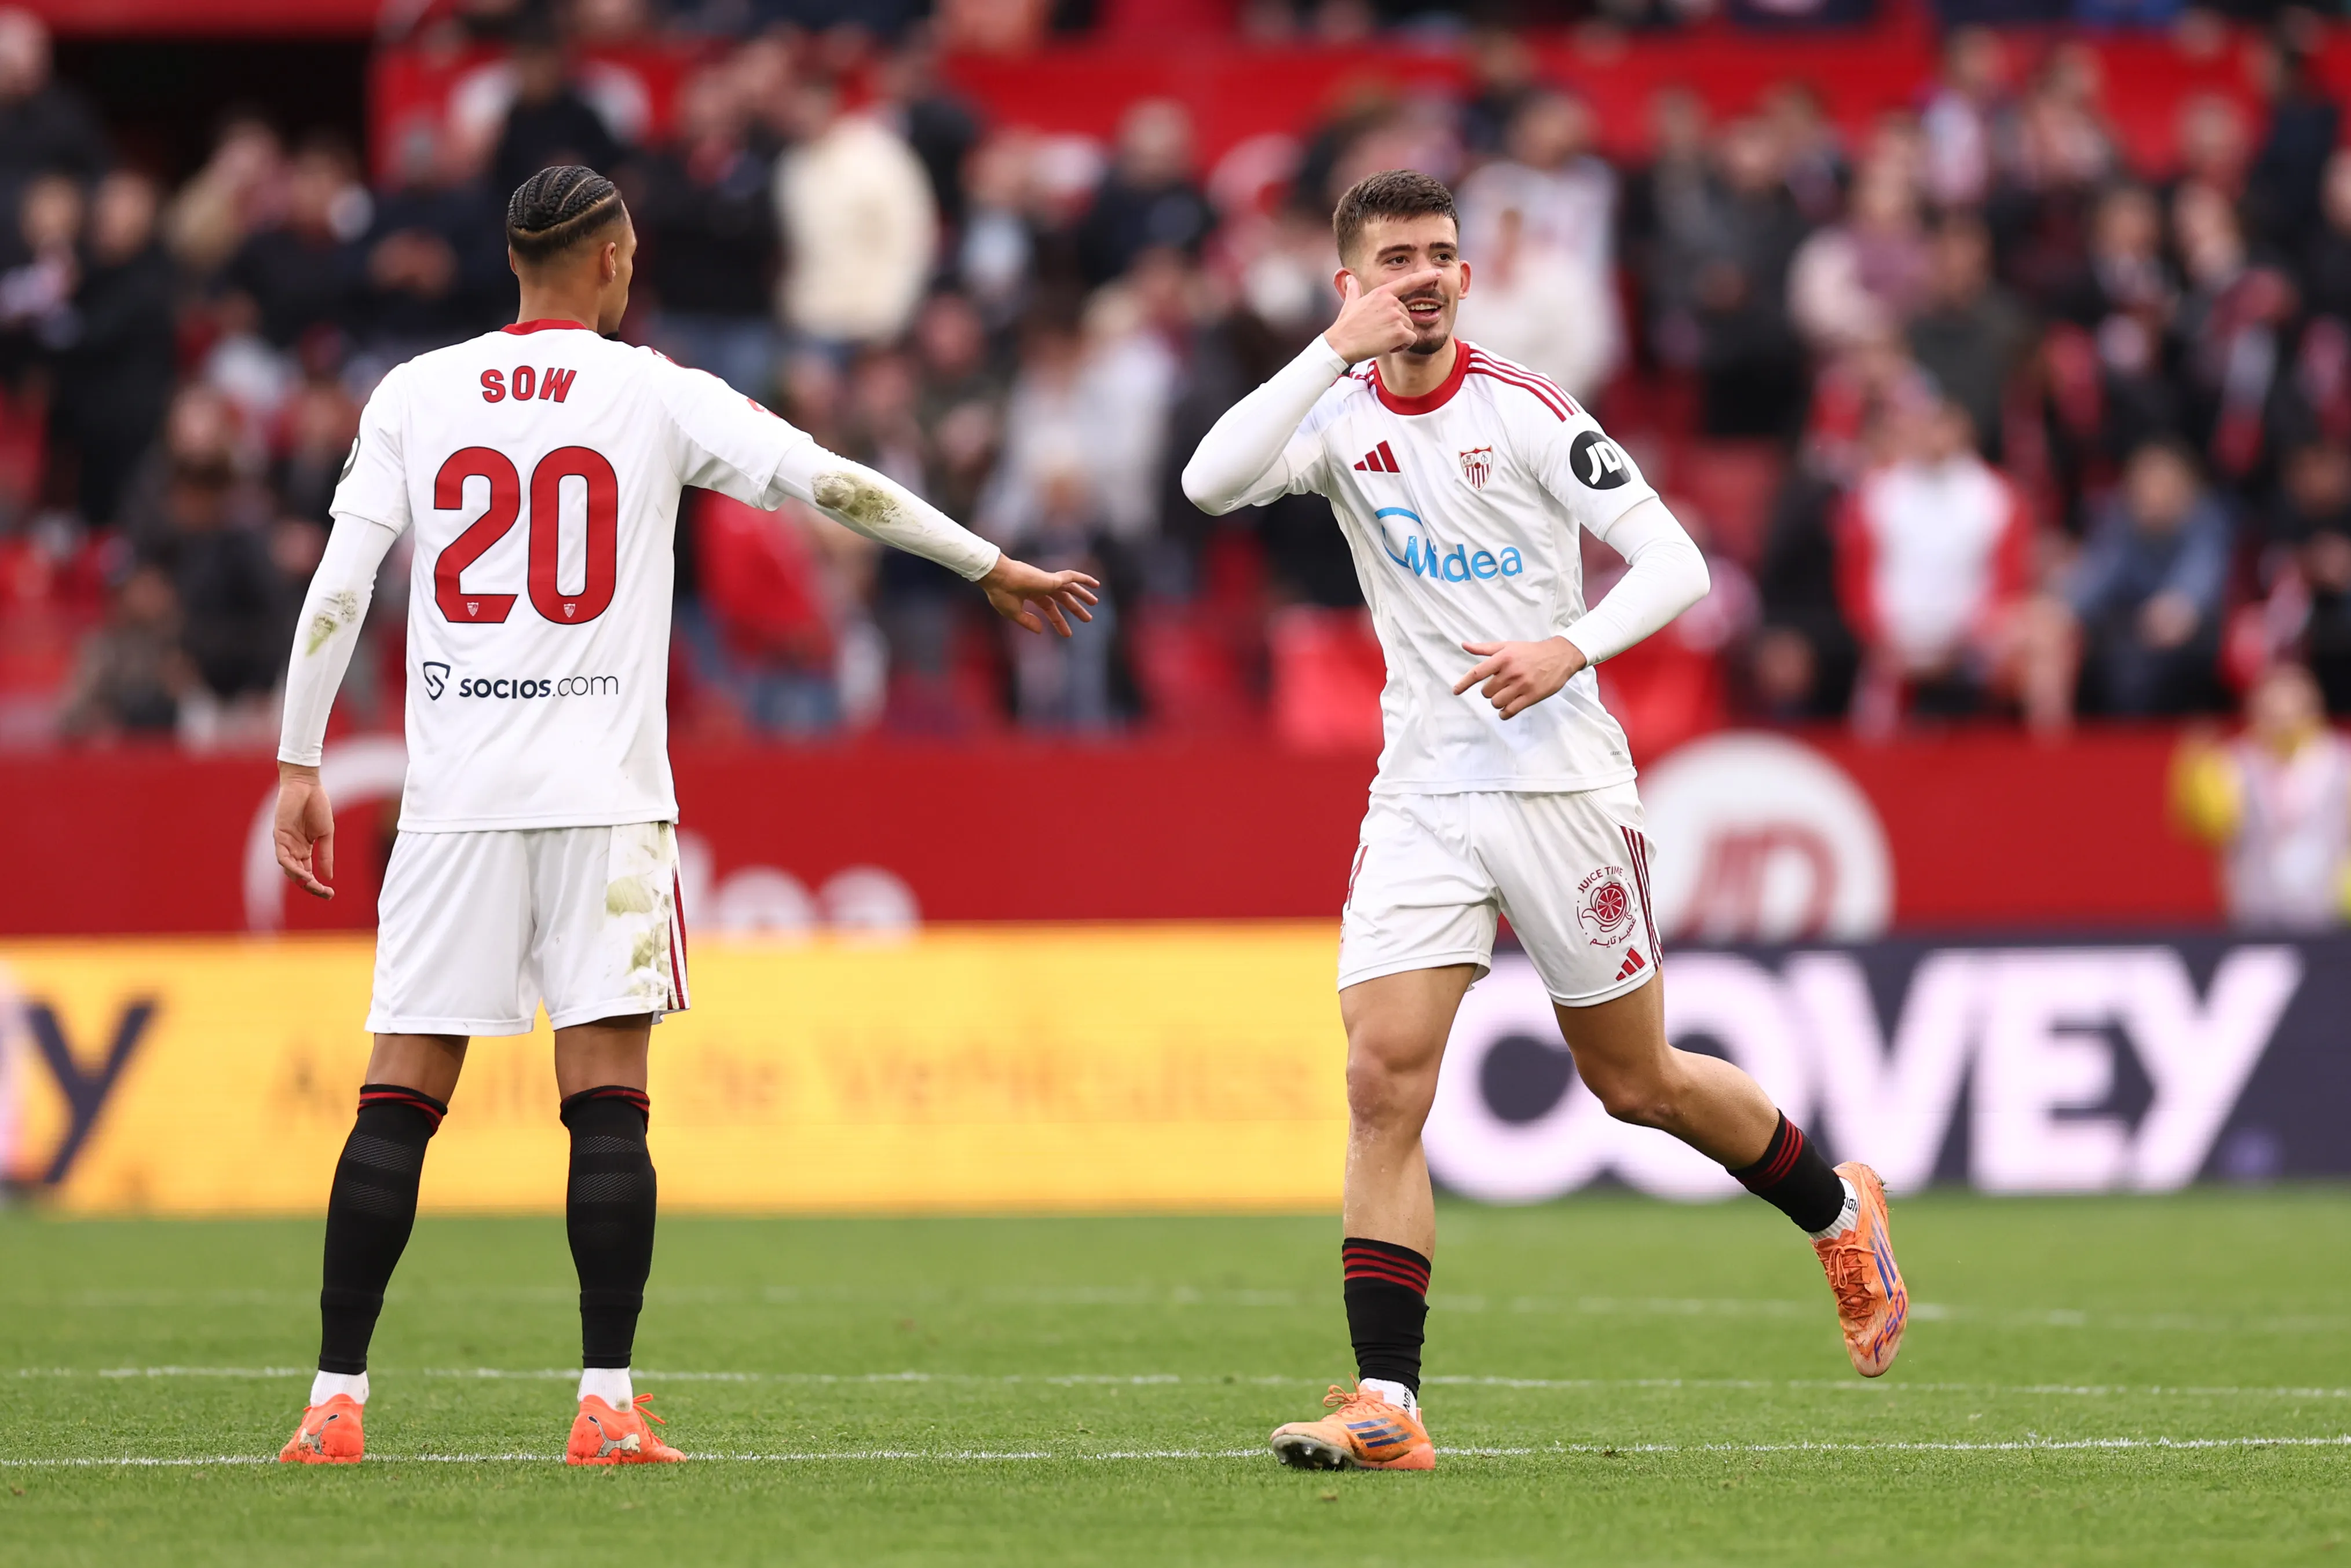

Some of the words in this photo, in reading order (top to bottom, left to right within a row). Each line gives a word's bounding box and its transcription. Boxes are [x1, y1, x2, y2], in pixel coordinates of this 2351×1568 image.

[480, 365, 577, 403] SOW
[1585, 440, 1622, 485] JD
[434, 445, 619, 625] 20
[1376, 507, 1523, 583] Midea
[1577, 868, 1604, 894] JUICE
[1604, 865, 1624, 877] TIME
